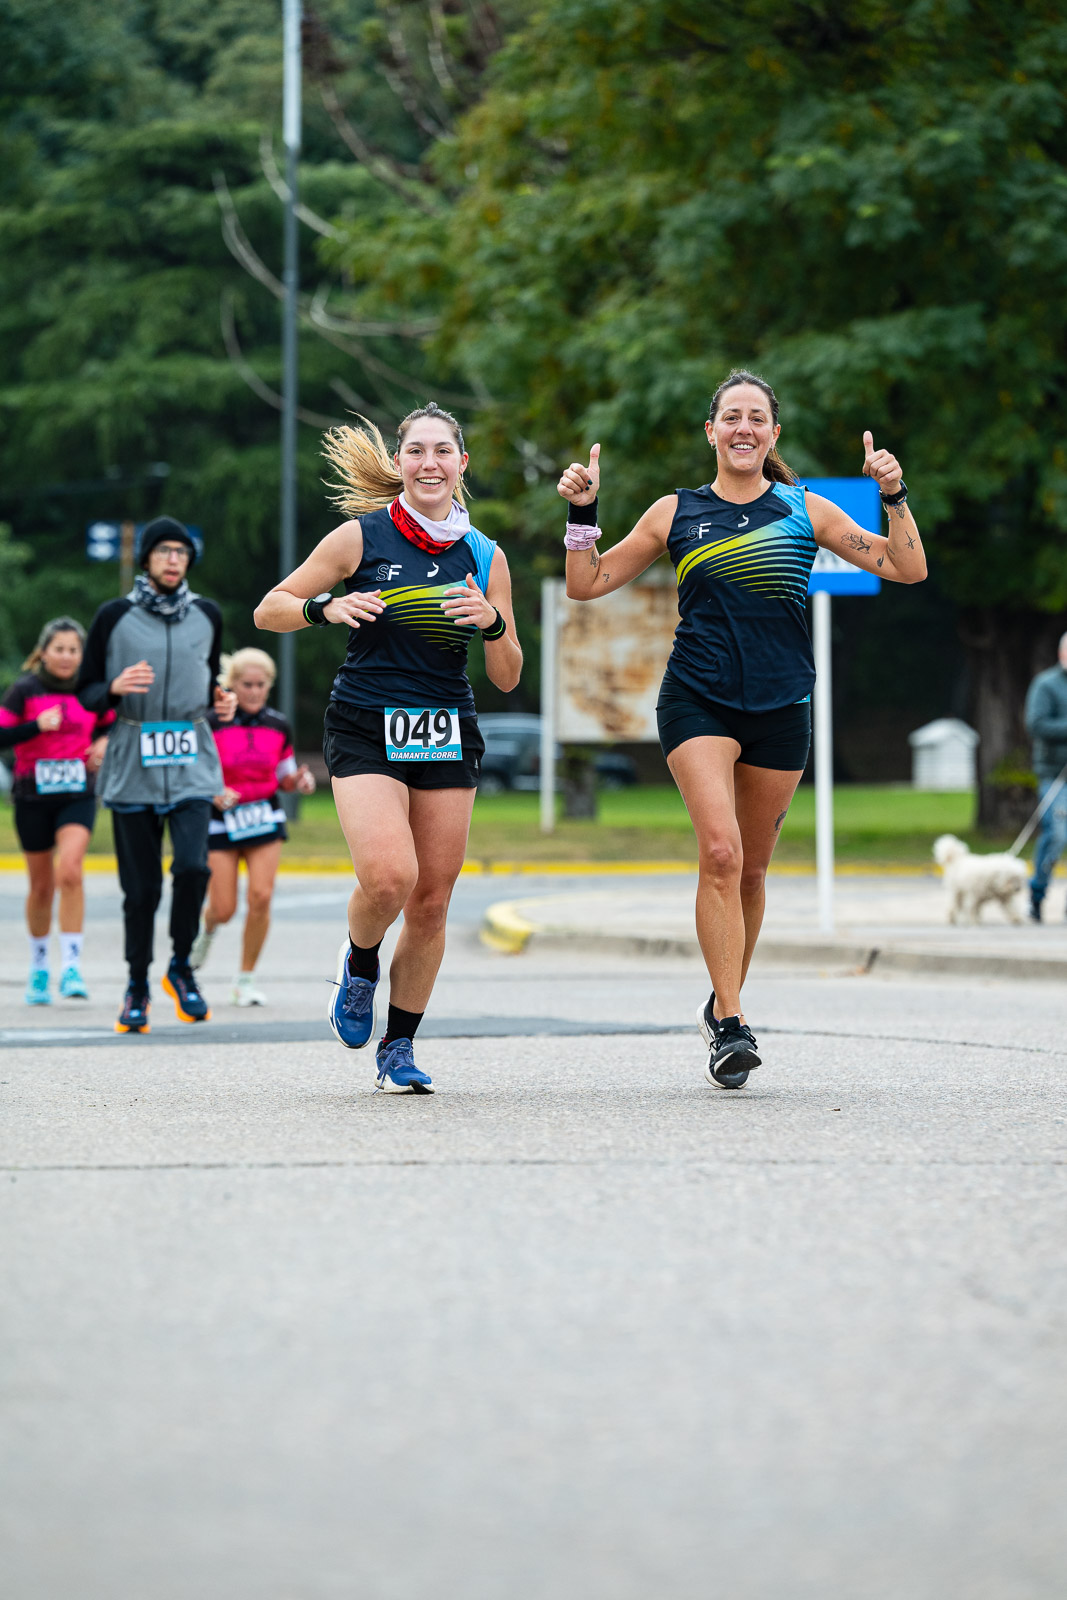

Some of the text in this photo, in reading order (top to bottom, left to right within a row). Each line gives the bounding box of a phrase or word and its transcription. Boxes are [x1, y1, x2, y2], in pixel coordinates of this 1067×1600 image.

[686, 522, 712, 542] SF
[376, 564, 402, 582] SF
[389, 708, 453, 749] 049
[148, 730, 191, 757] 106
[431, 751, 458, 759] CORRE
